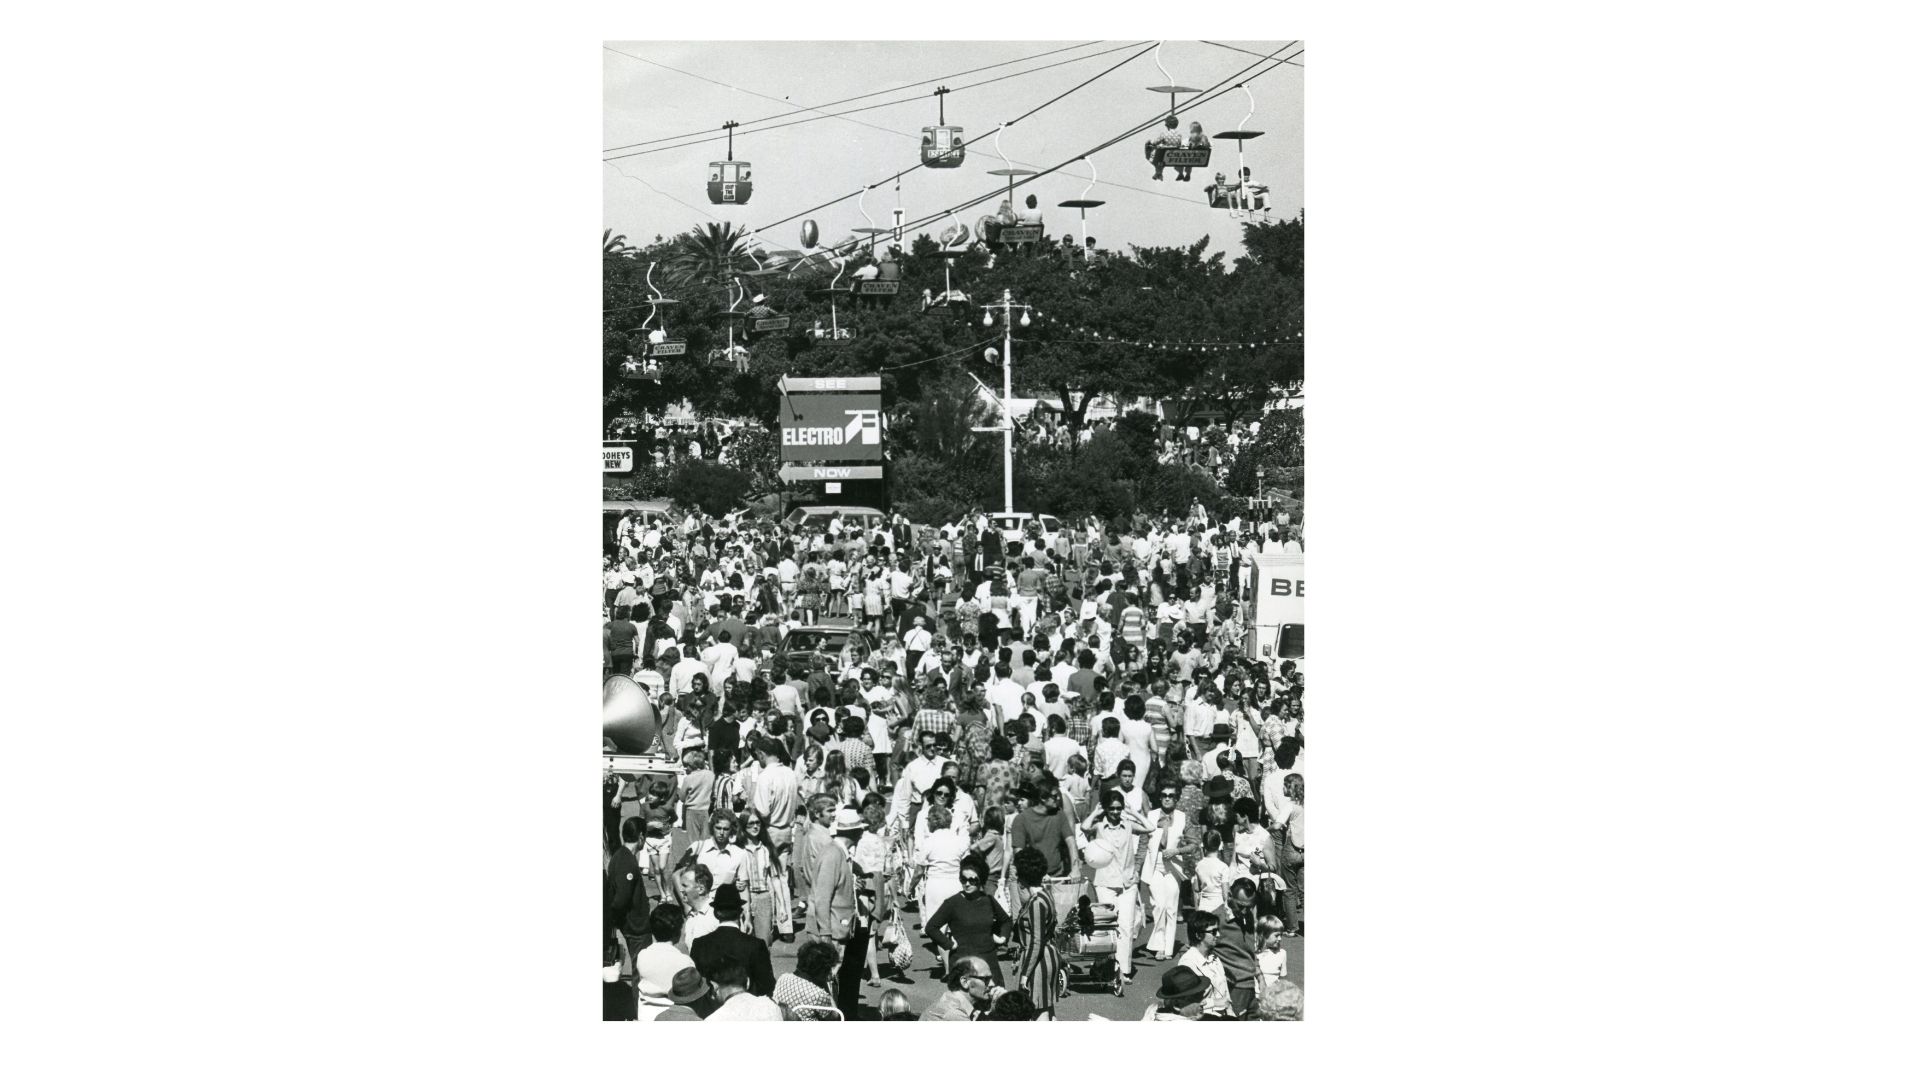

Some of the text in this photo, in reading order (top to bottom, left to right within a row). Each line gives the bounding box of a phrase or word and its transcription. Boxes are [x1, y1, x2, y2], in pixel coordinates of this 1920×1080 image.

[1166, 150, 1207, 158] CRAVEN
[814, 379, 847, 389] SEE
[782, 426, 843, 446] ELECTRO
[605, 459, 621, 469] NEW
[814, 468, 851, 478] NOW
